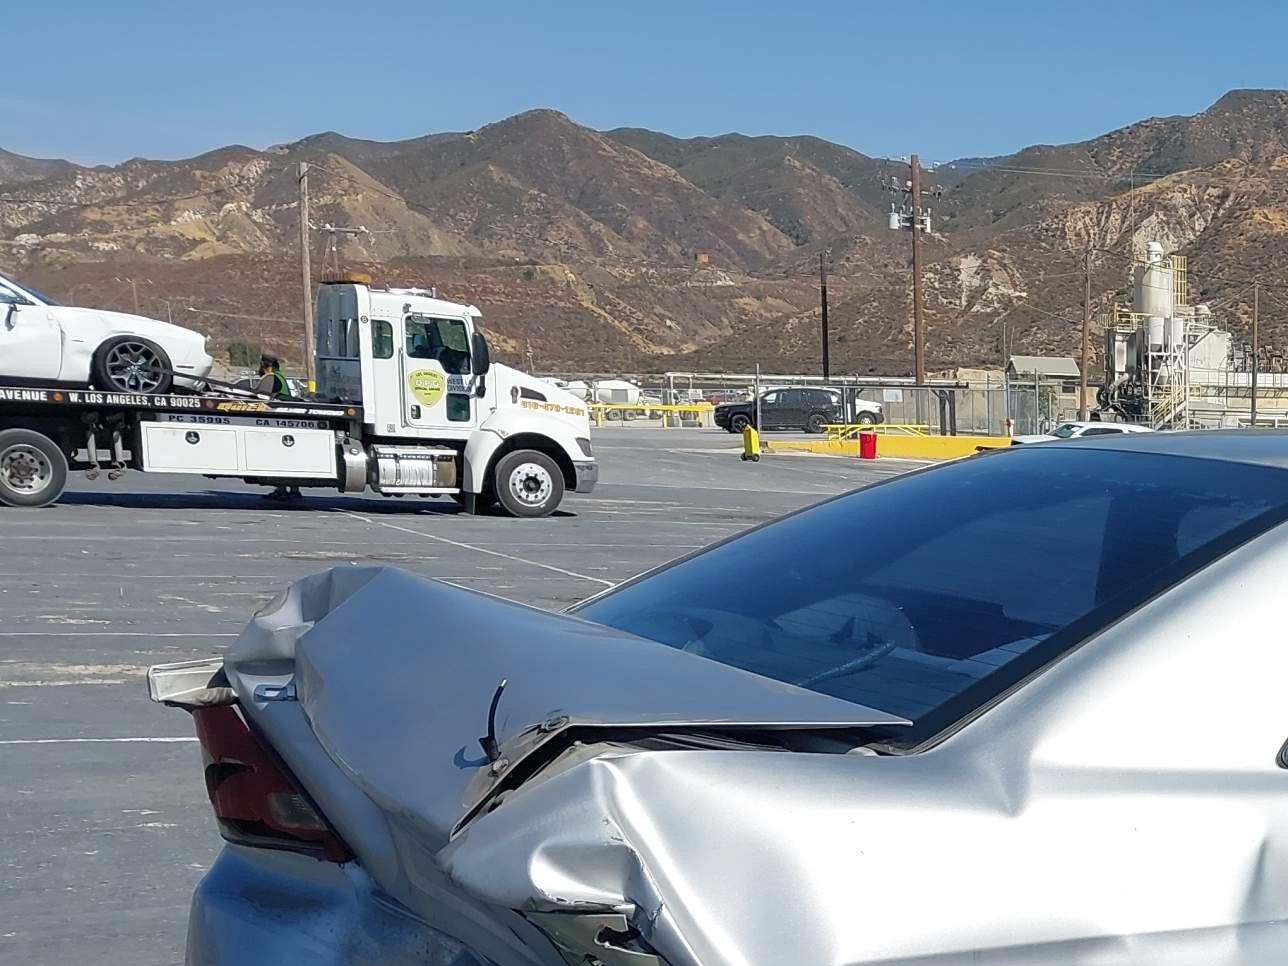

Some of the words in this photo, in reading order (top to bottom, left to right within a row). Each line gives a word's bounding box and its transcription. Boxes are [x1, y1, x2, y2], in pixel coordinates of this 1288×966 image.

[0, 389, 48, 401] AVENUE
[68, 392, 82, 403] W.
[84, 393, 103, 404] LOS
[106, 394, 151, 406] ANGELES,
[154, 396, 167, 407] CA
[170, 397, 201, 408] 90025
